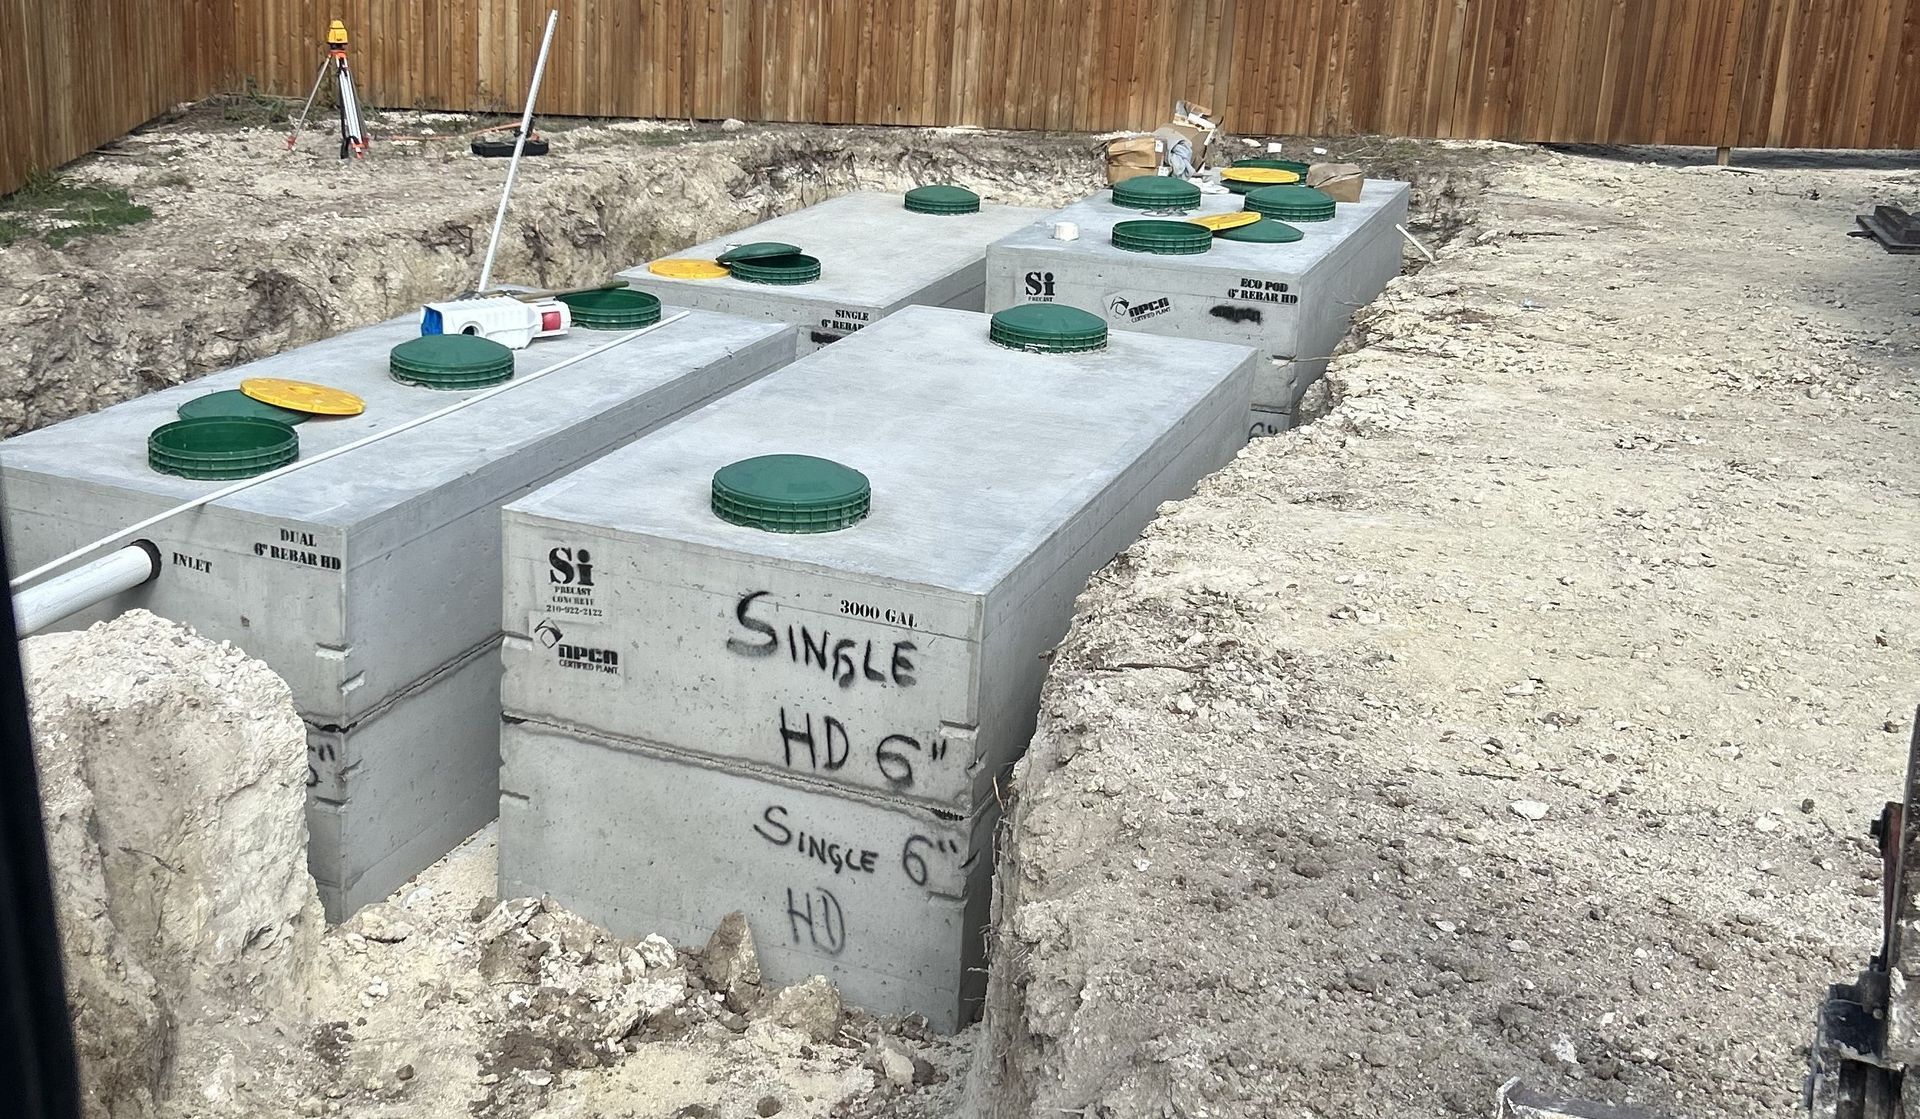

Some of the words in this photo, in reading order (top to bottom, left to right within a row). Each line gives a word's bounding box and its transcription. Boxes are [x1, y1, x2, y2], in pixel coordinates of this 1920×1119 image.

[1025, 272, 1055, 296] Si
[1240, 278, 1262, 289] ECO
[1265, 281, 1288, 292] POD
[1240, 290, 1279, 302] REBAR
[1281, 294, 1298, 304] HD
[835, 309, 869, 321] SINGLE
[280, 528, 317, 547] DUAL
[173, 552, 212, 573] INLET
[270, 545, 318, 566] REBAR
[320, 554, 341, 570] HD
[549, 547, 594, 586] Si
[554, 586, 591, 596] PRECAST
[552, 596, 594, 606] CONCRETE
[546, 605, 603, 617] 210-922-2122
[840, 600, 880, 620] 3000
[885, 608, 918, 629] GAL
[559, 660, 594, 671] CERTIFIED
[595, 664, 618, 675] PLANT
[780, 707, 850, 771] HD
[786, 887, 846, 956] HD
